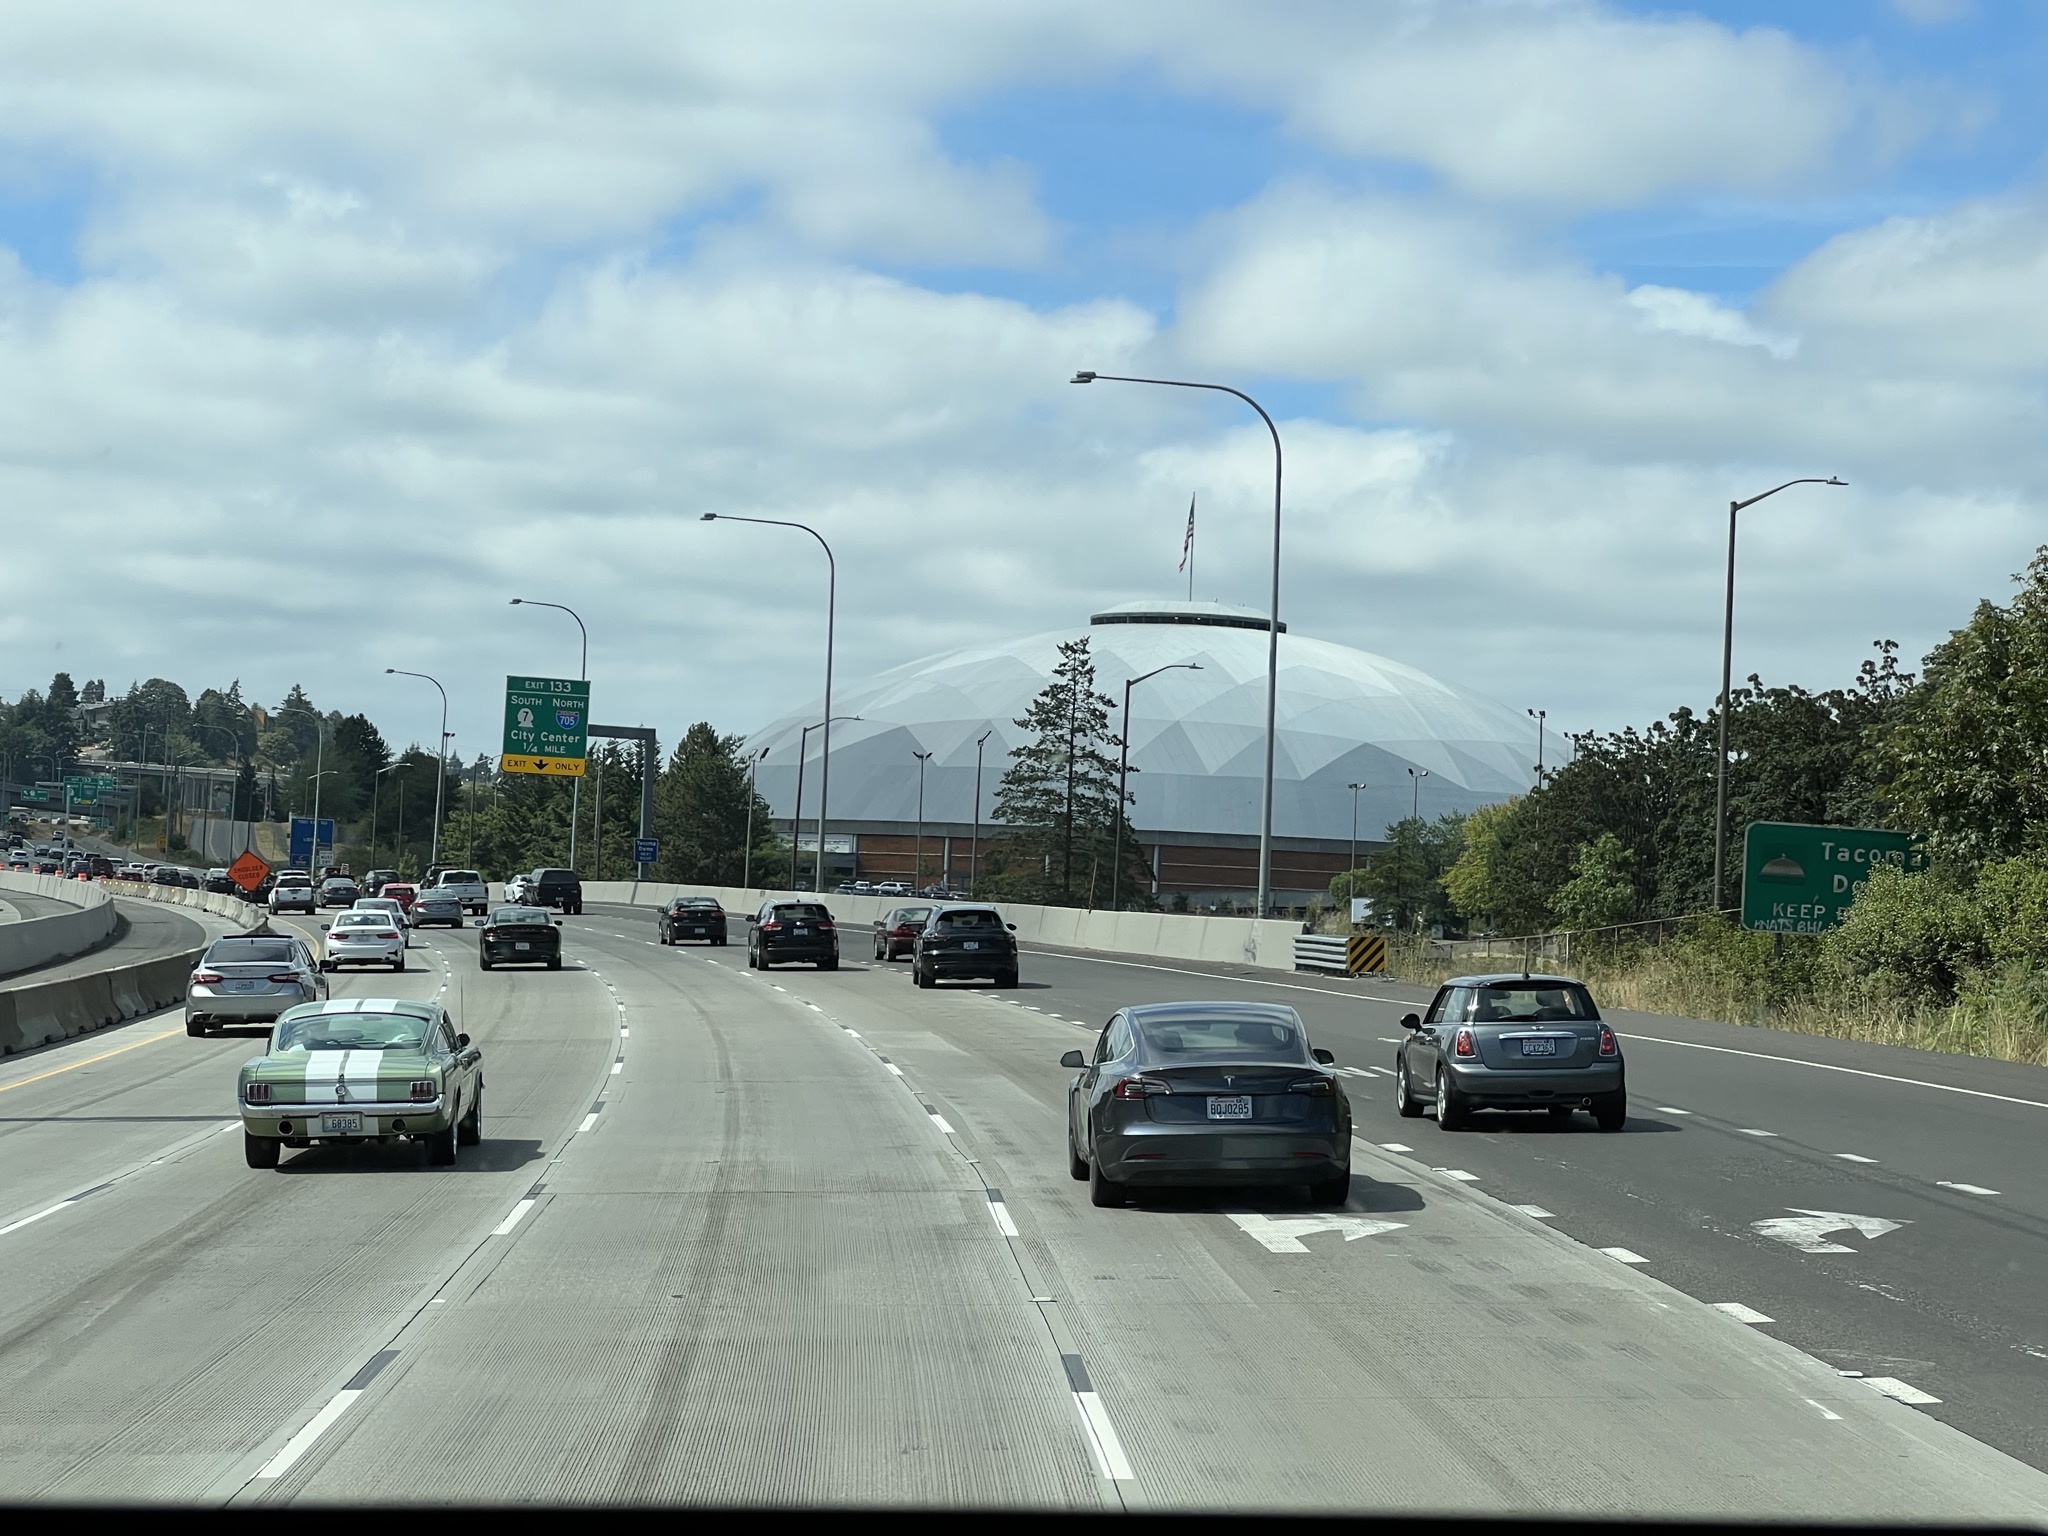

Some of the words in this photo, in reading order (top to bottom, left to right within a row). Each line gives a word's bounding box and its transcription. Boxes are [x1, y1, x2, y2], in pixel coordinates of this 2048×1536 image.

[525, 681, 544, 689] EXIT
[550, 682, 571, 692] 133
[511, 695, 542, 705] SOUTH
[552, 698, 584, 708] NORTH
[523, 711, 529, 721] 7
[560, 716, 575, 726] 705
[511, 730, 535, 742] City
[540, 732, 580, 743] Center
[544, 745, 566, 753] MILE
[555, 762, 579, 770] ONLY
[1773, 902, 1826, 919] KEEP
